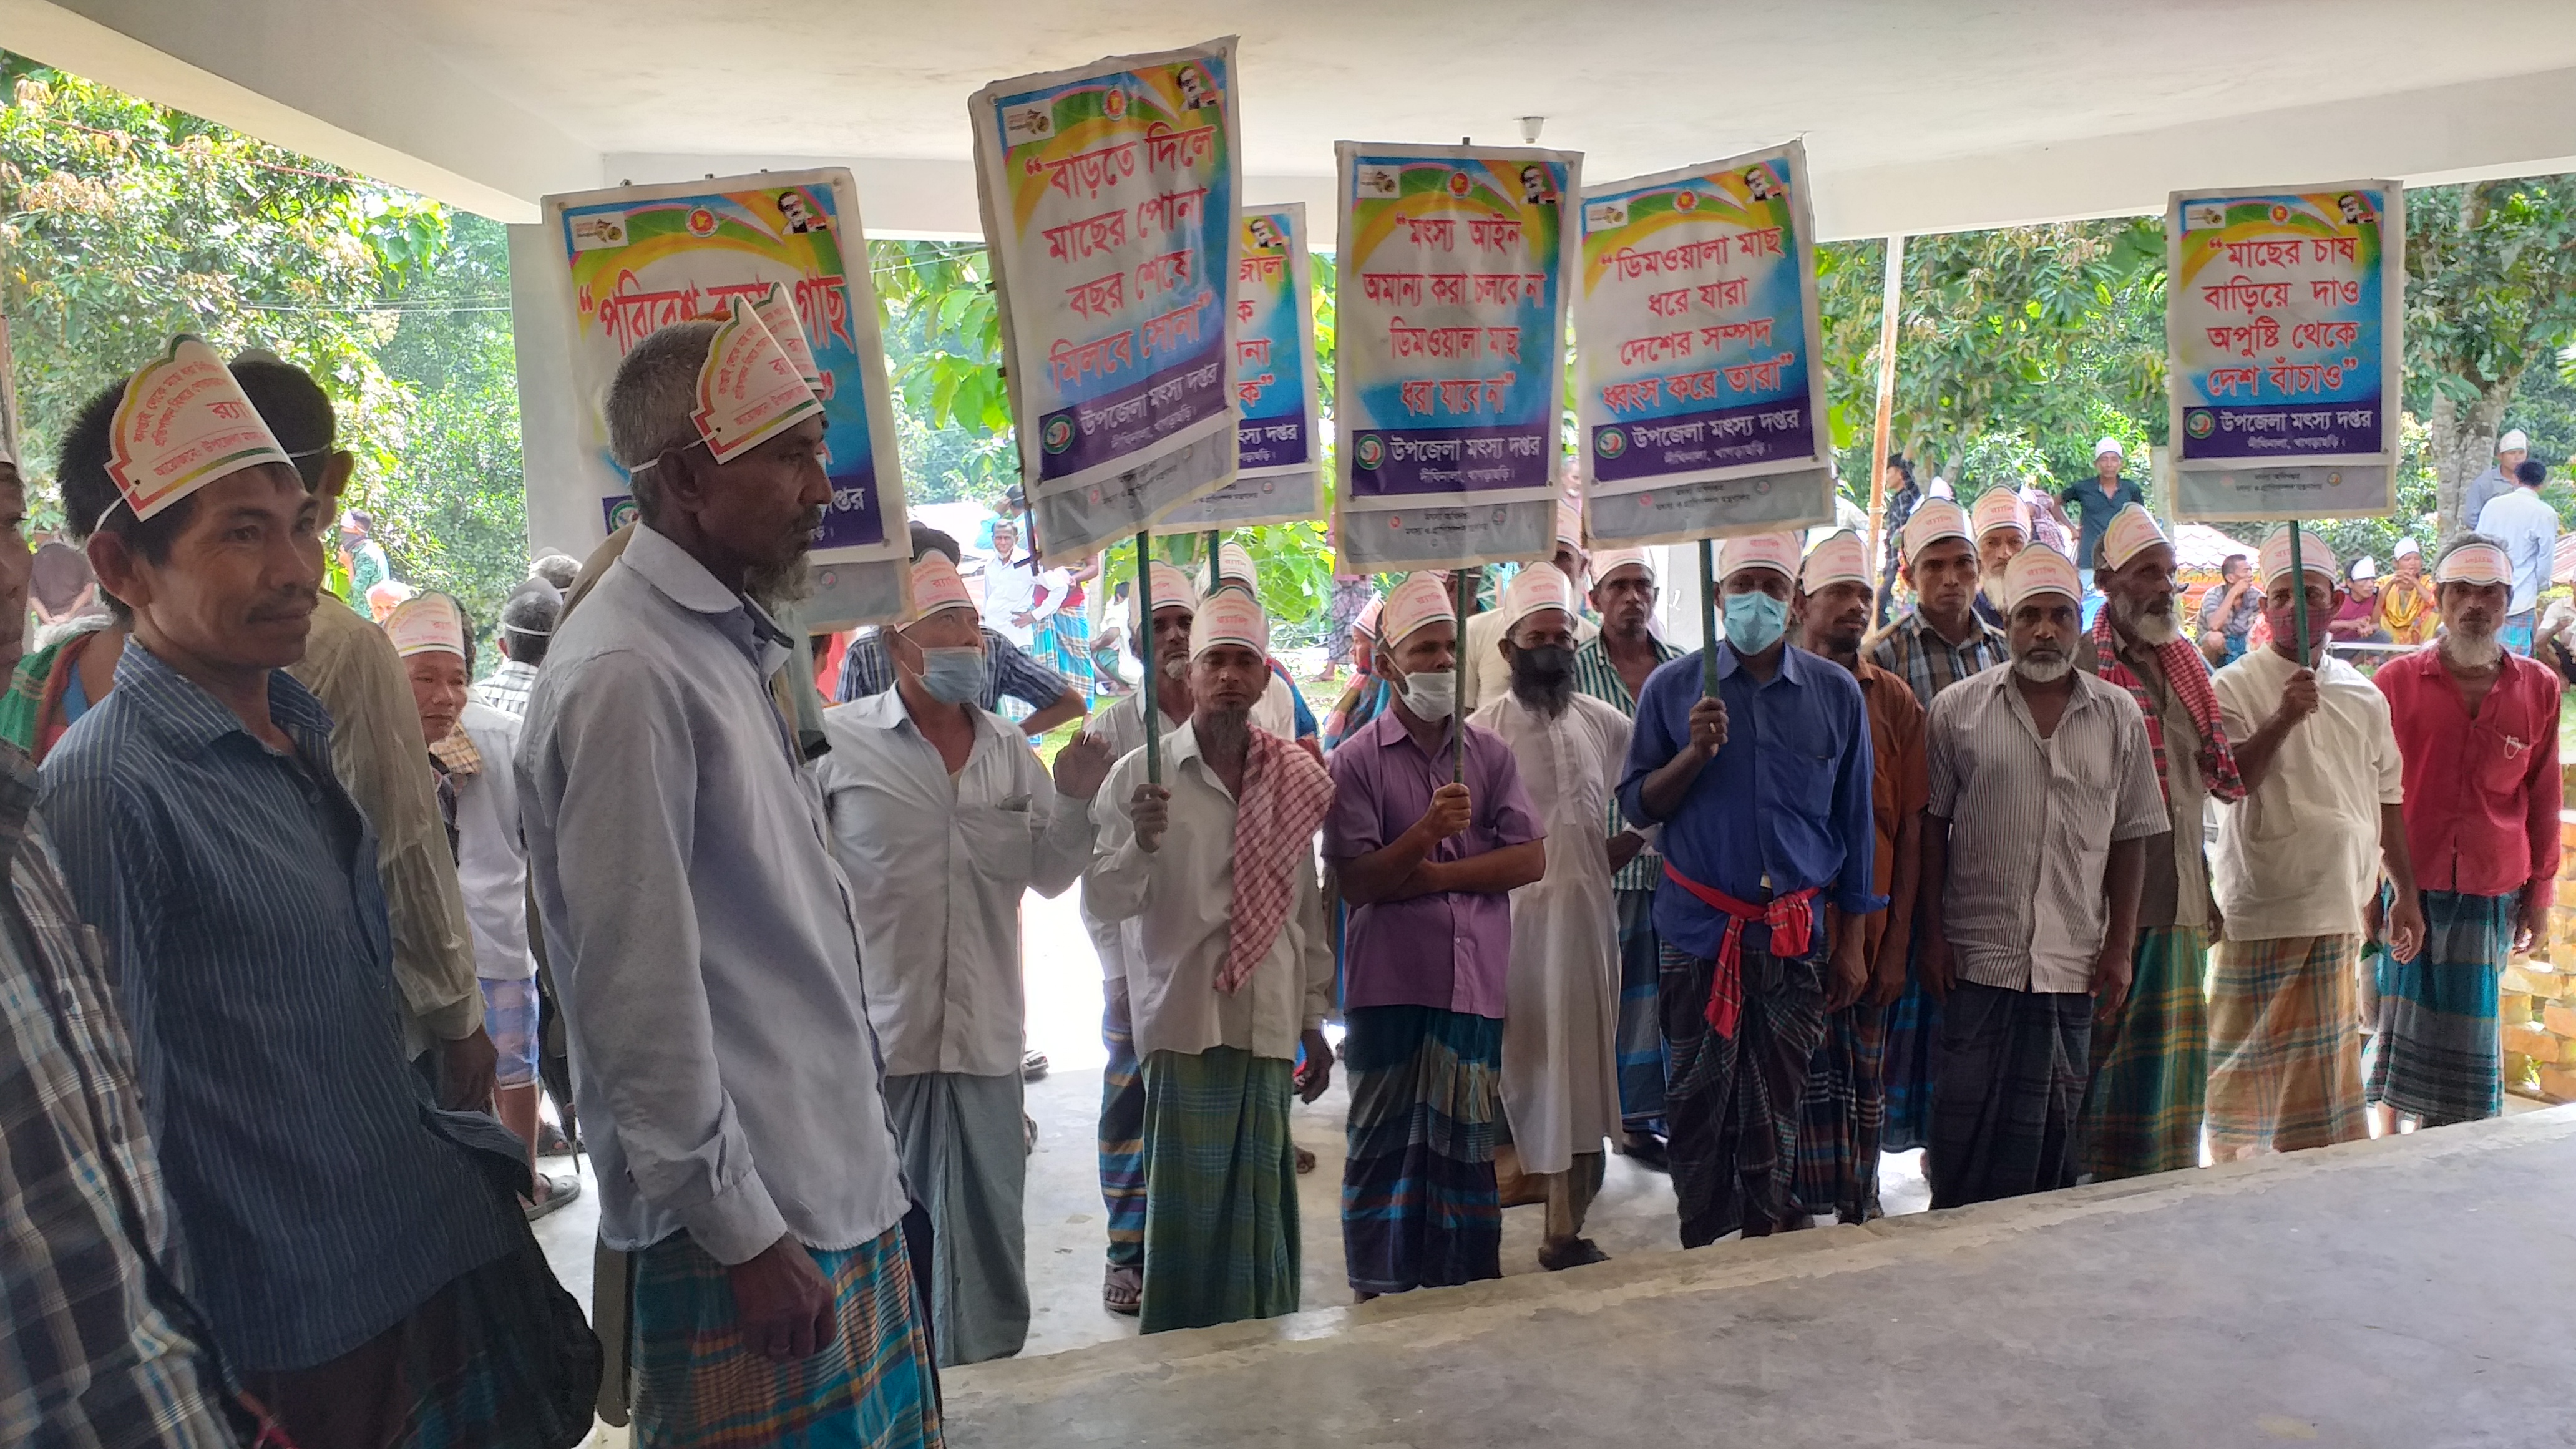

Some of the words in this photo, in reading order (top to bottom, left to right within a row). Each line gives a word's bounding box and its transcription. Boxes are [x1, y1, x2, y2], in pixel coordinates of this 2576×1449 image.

[1142, 121, 1217, 175] দিলে
[1041, 208, 1128, 262] মাছের
[1136, 184, 1209, 239] পোনা
[1468, 212, 1521, 256] আইন
[1736, 227, 1785, 258] মাছ
[2208, 238, 2303, 269] “মাছের
[2310, 236, 2359, 265] চাষ
[1065, 272, 1125, 321] বছর
[1134, 249, 1194, 301] শেষে
[1362, 270, 1425, 307] অমান্য
[1427, 270, 1468, 306] করা
[1471, 273, 1521, 306] চলবে
[1524, 270, 1548, 308] না
[1648, 288, 1690, 317] ধরে
[1697, 276, 1749, 310] যারা
[2200, 274, 2293, 315] বাড়িয়ে
[2309, 276, 2360, 307] দাও
[1389, 315, 1483, 360] ডিমওয়ালা
[1486, 326, 1521, 364] মাছ
[1620, 331, 1693, 366] দেশের
[1699, 317, 1775, 352] সম্পদ
[2205, 315, 2280, 358] অপুষ্টি
[2291, 320, 2360, 349] থেকে
[1049, 329, 1134, 393] মিলবে
[2207, 364, 2261, 396] দেশ
[1402, 377, 1436, 417] ধরা
[1439, 378, 1482, 415] যাবে
[1602, 378, 1661, 414] ধ্বংস
[1664, 370, 1719, 403] করে
[1080, 393, 1148, 436] উপজেলা
[1631, 421, 1705, 448] উপজেলা
[1707, 415, 1755, 438] মৎস্য
[1758, 409, 1800, 432] দপ্তর
[2219, 409, 2288, 432] উপজেলা
[2290, 411, 2333, 431] মৎস্য
[2334, 409, 2373, 430] দপ্তর
[1389, 435, 1462, 462] উপজেলা
[1463, 437, 1505, 459] মৎস্য
[1507, 435, 1543, 457] দপ্তর
